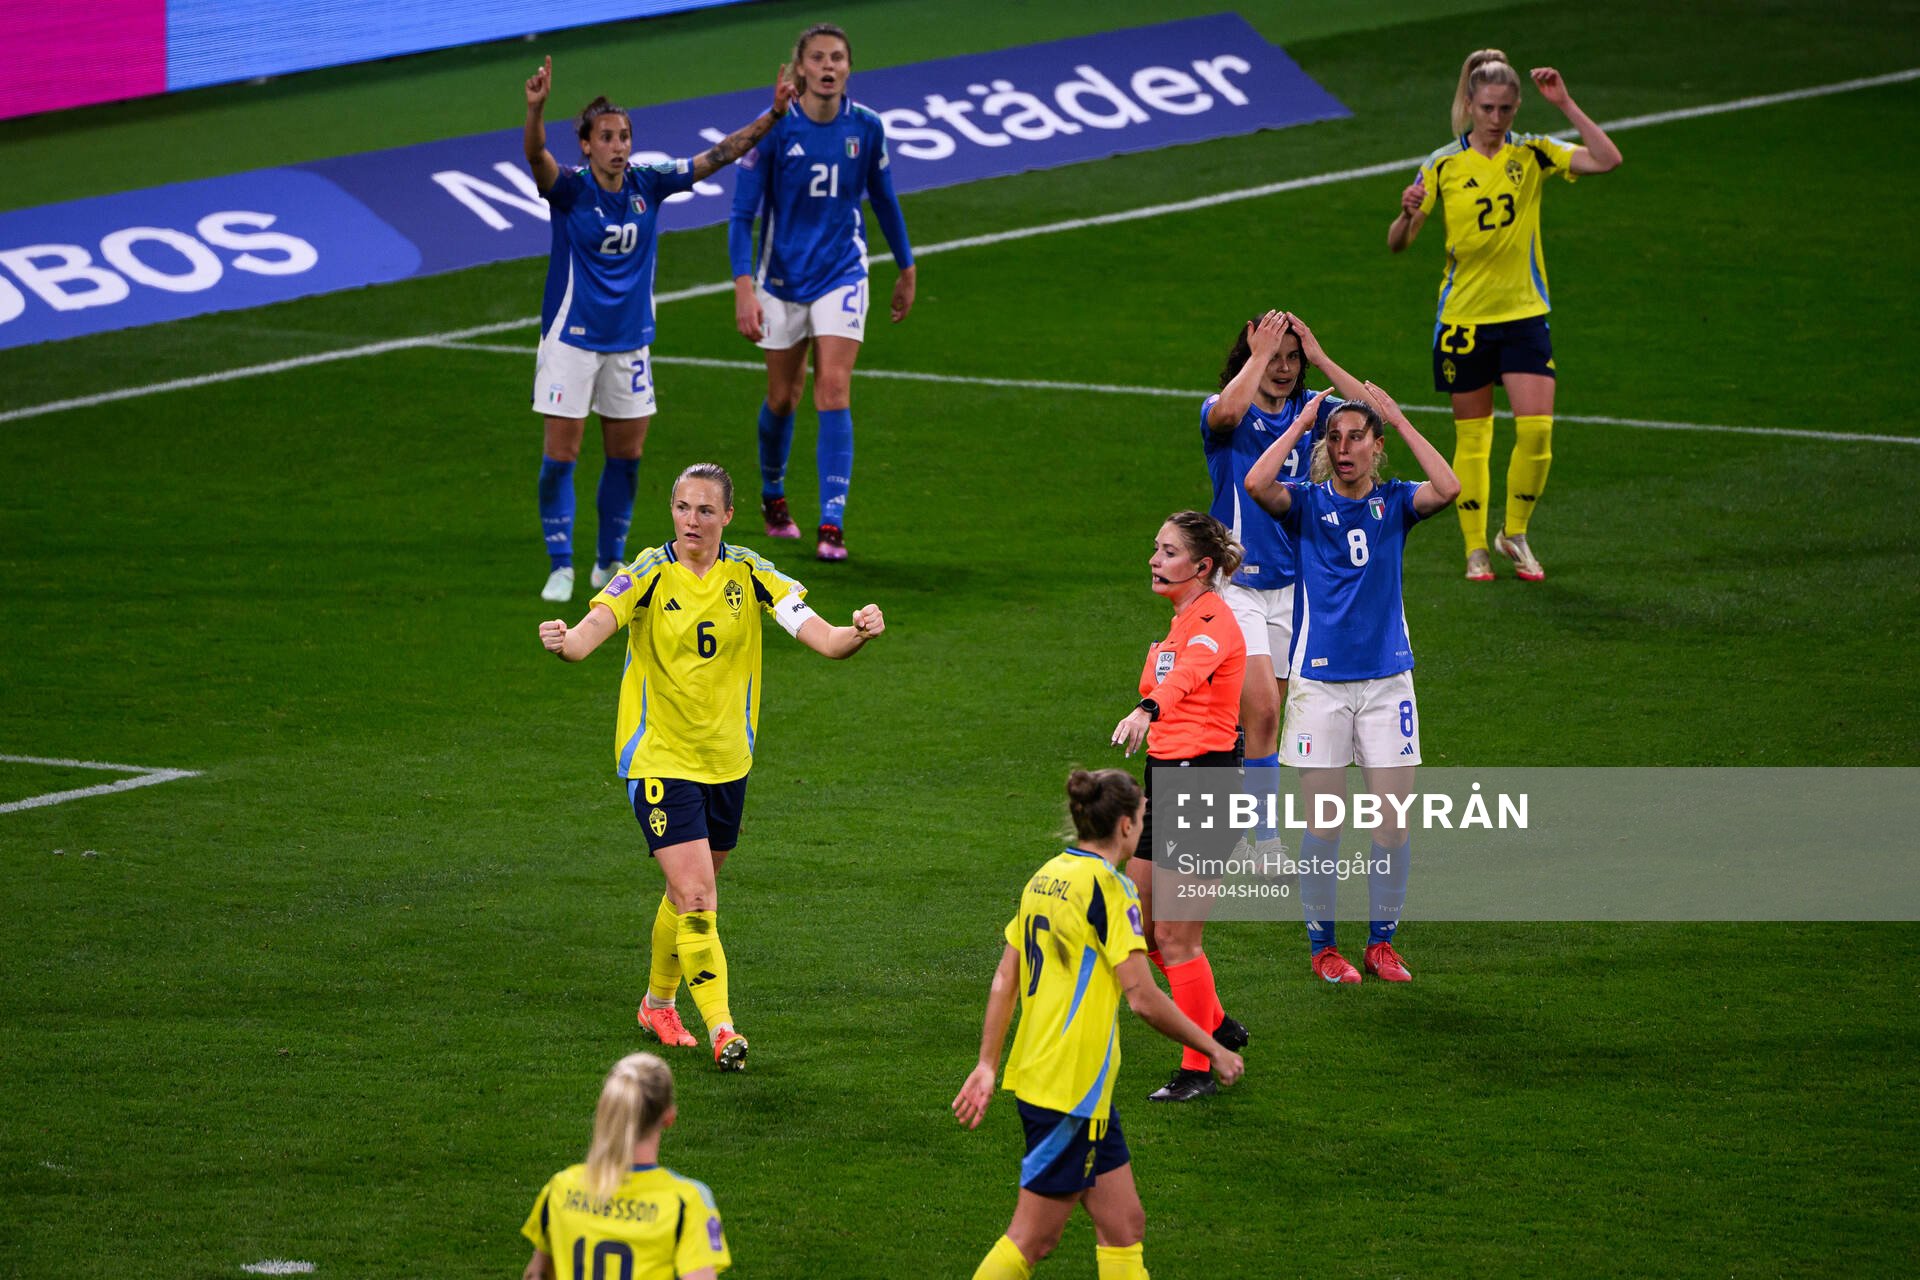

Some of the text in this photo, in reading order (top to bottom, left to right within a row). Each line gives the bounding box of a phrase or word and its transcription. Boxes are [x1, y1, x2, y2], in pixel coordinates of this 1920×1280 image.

[809, 162, 839, 198] 21
[1476, 193, 1516, 232] 23
[600, 222, 638, 255] 20
[0, 211, 319, 325] BOS
[1440, 325, 1477, 355] 23
[1347, 528, 1370, 567] 8
[697, 621, 717, 659] 6
[1399, 700, 1414, 738] 8
[644, 778, 664, 804] 6
